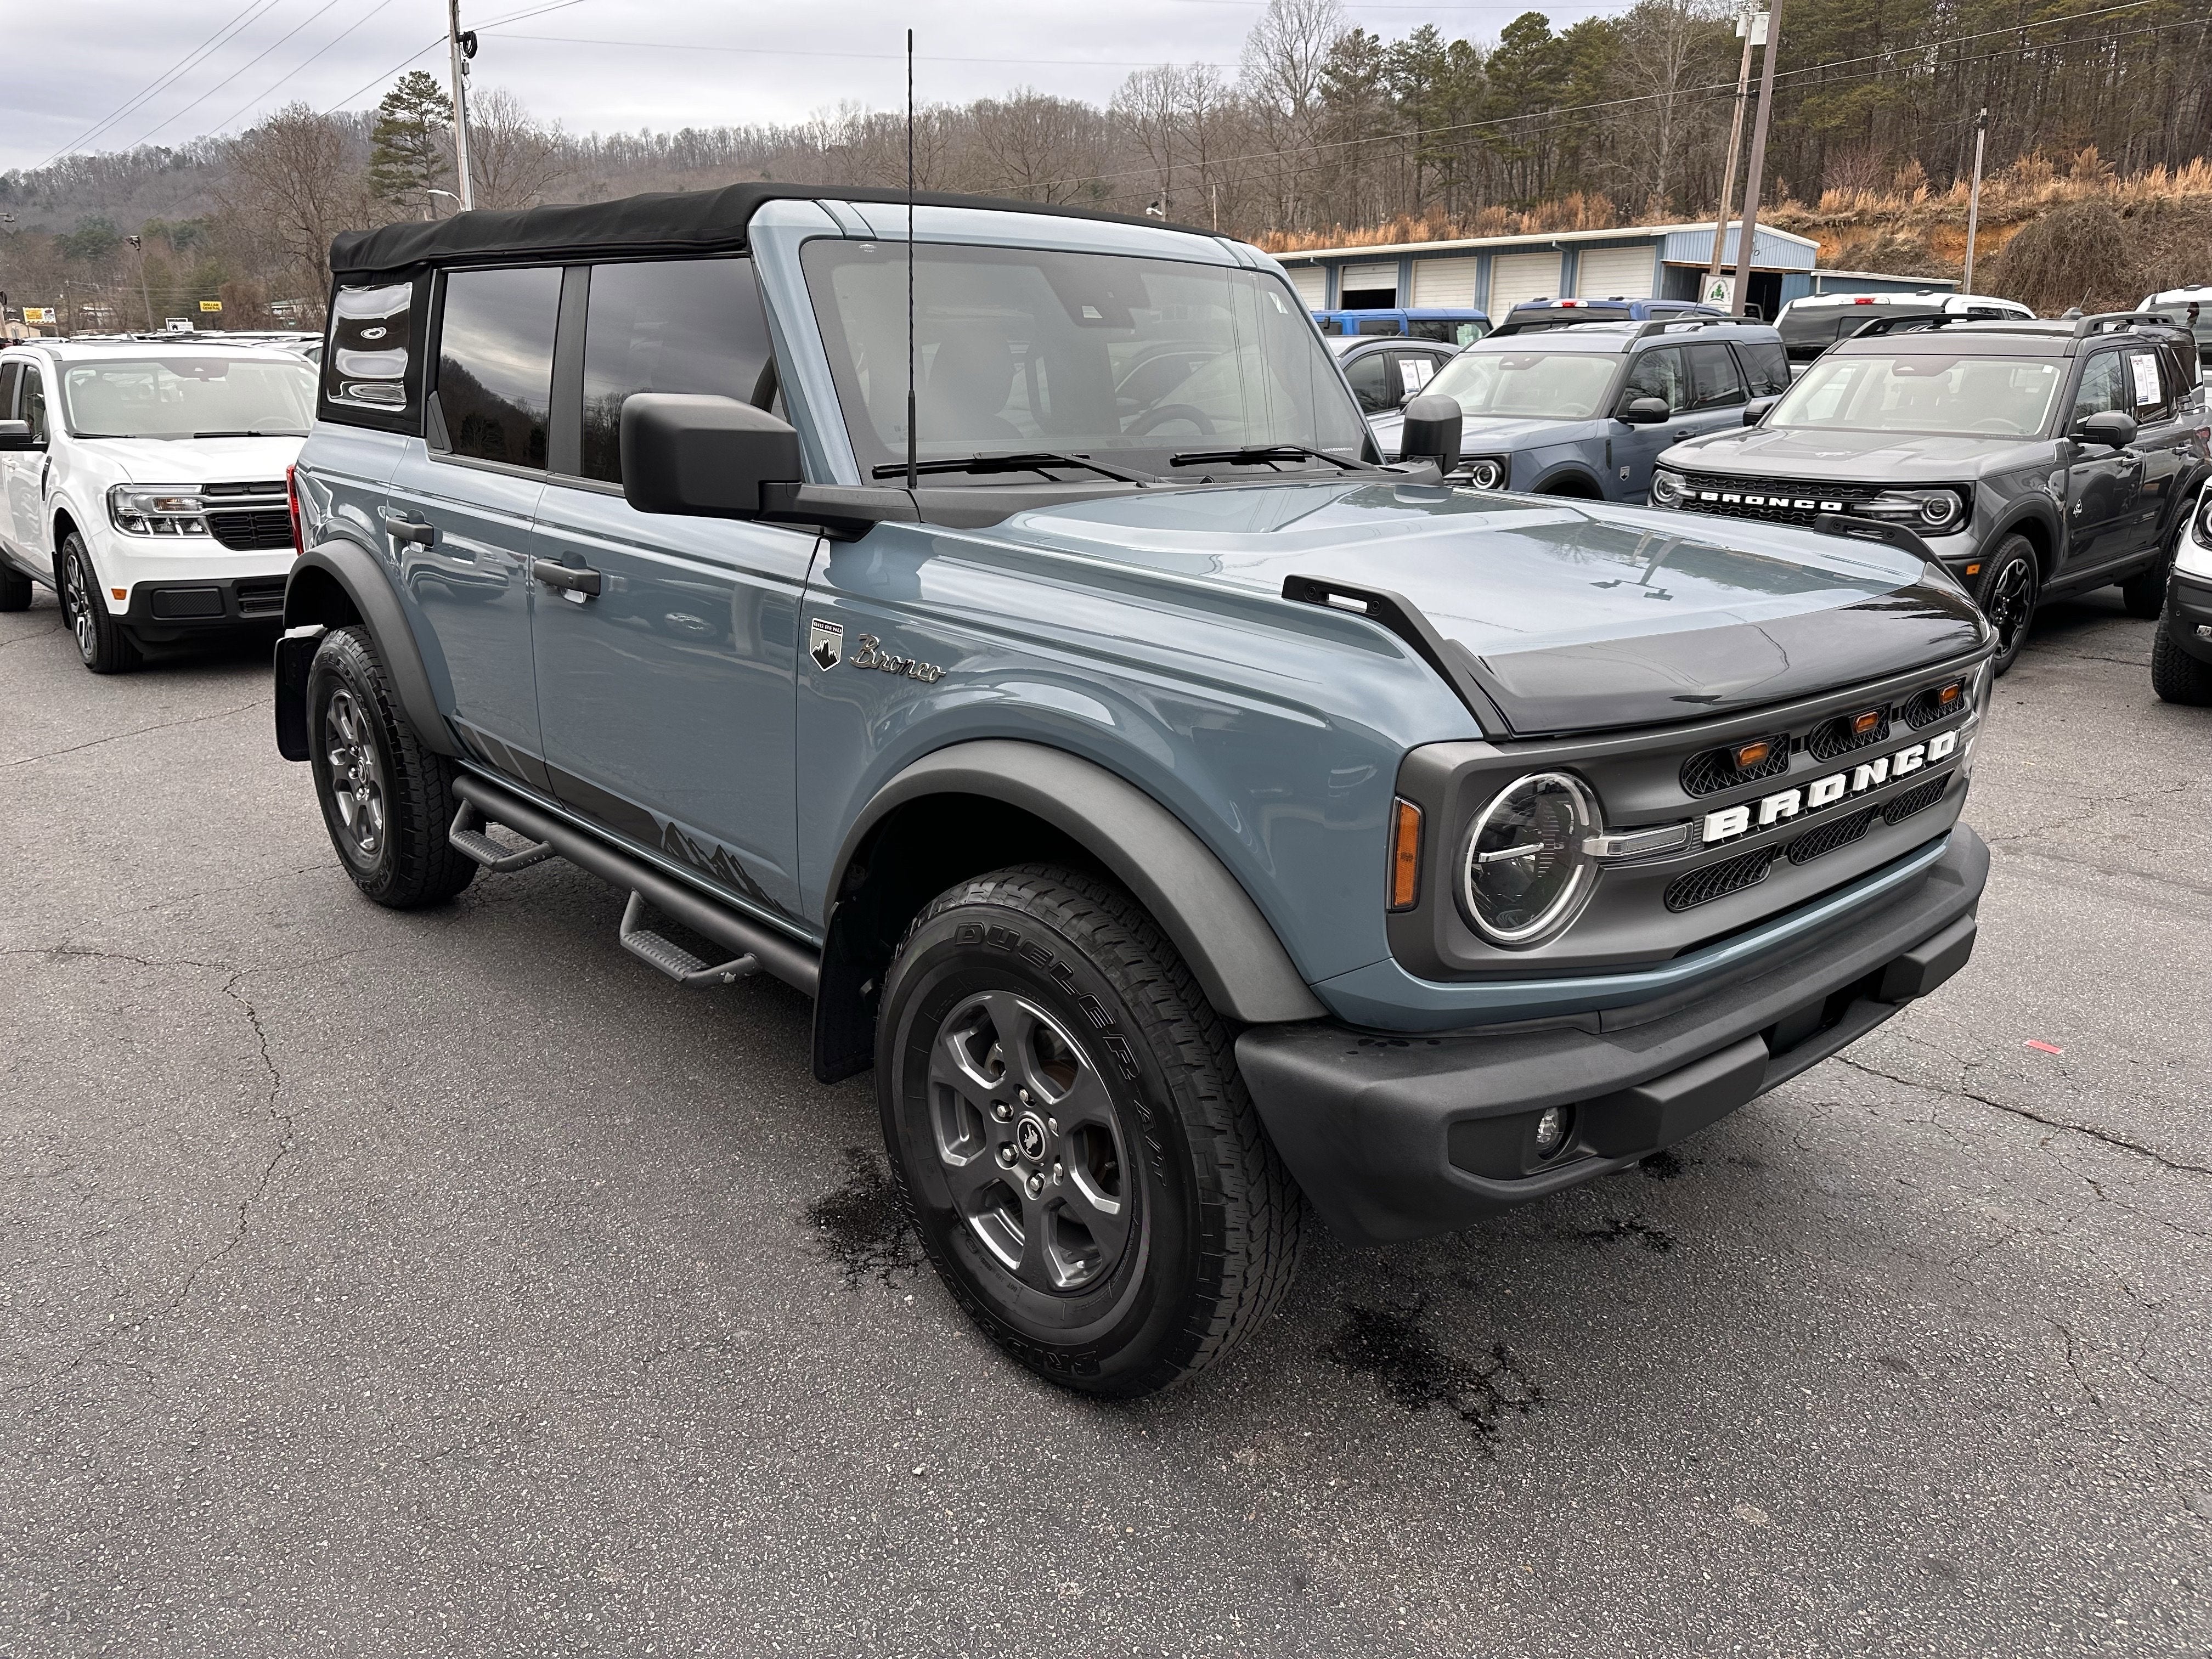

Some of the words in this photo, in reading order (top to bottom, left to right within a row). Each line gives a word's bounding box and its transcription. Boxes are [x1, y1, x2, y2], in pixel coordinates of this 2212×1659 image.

[1701, 492, 1842, 511] BRONCO
[825, 624, 842, 633] BEND
[849, 633, 947, 684] Bronco
[1702, 730, 1957, 843] BRONCO
[953, 922, 1142, 1081] DUELER
[1133, 1099, 1167, 1188] A/T
